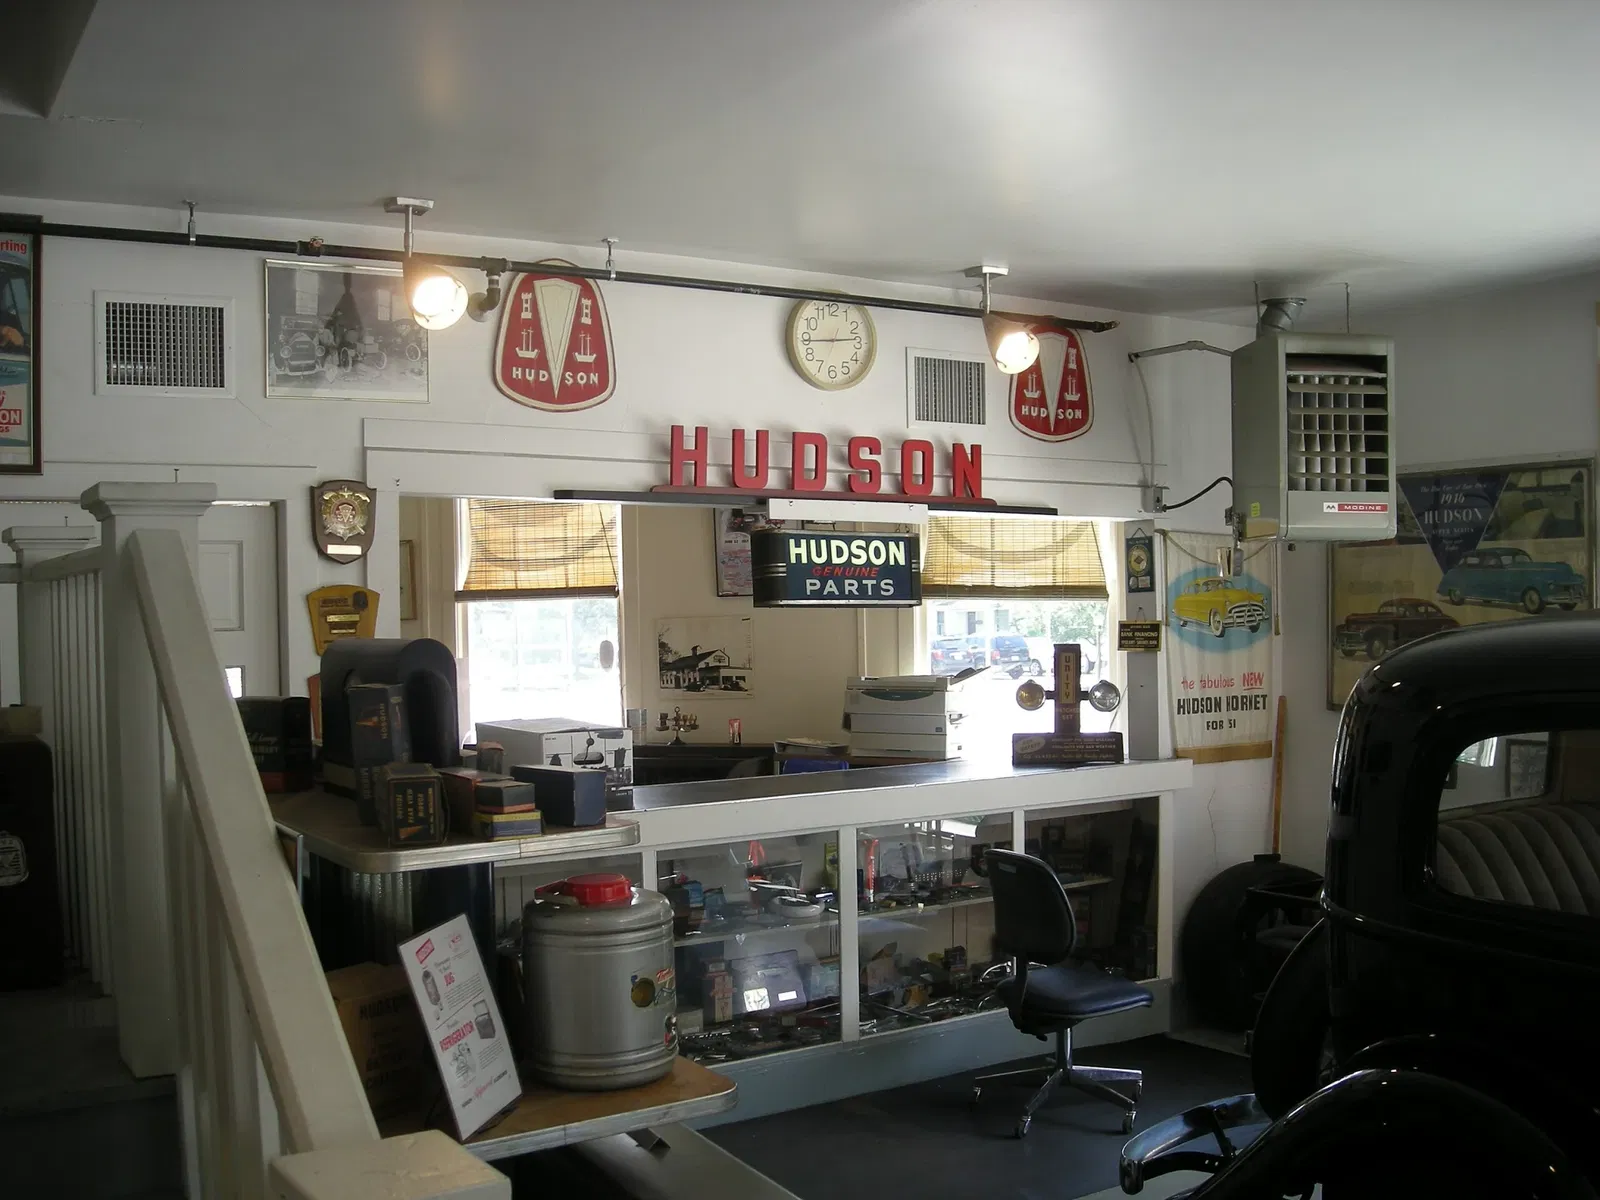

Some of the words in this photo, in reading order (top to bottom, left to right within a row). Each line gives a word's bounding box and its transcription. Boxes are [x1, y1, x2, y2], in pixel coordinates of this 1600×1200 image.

[814, 307, 825, 320] 11
[825, 303, 839, 317] 12
[842, 309, 848, 322] 1
[804, 317, 818, 331] 10
[850, 321, 859, 334] 2
[801, 332, 811, 346] 9
[853, 336, 863, 350] 3
[805, 347, 815, 361] 8
[850, 351, 860, 365] 4
[815, 359, 825, 373] 7
[828, 365, 837, 379] 6
[841, 361, 850, 375] 5
[670, 425, 982, 498] HUDSON
[1441, 492, 1465, 505] 1946
[1424, 508, 1483, 525] HUDSON
[789, 538, 906, 566] HUDSON
[812, 566, 880, 577] GENUINE
[805, 579, 895, 596] PARTS
[1242, 672, 1264, 687] NEW
[1177, 697, 1222, 715] HUDSON
[1226, 694, 1268, 712] HORNET
[1206, 720, 1224, 730] FOR
